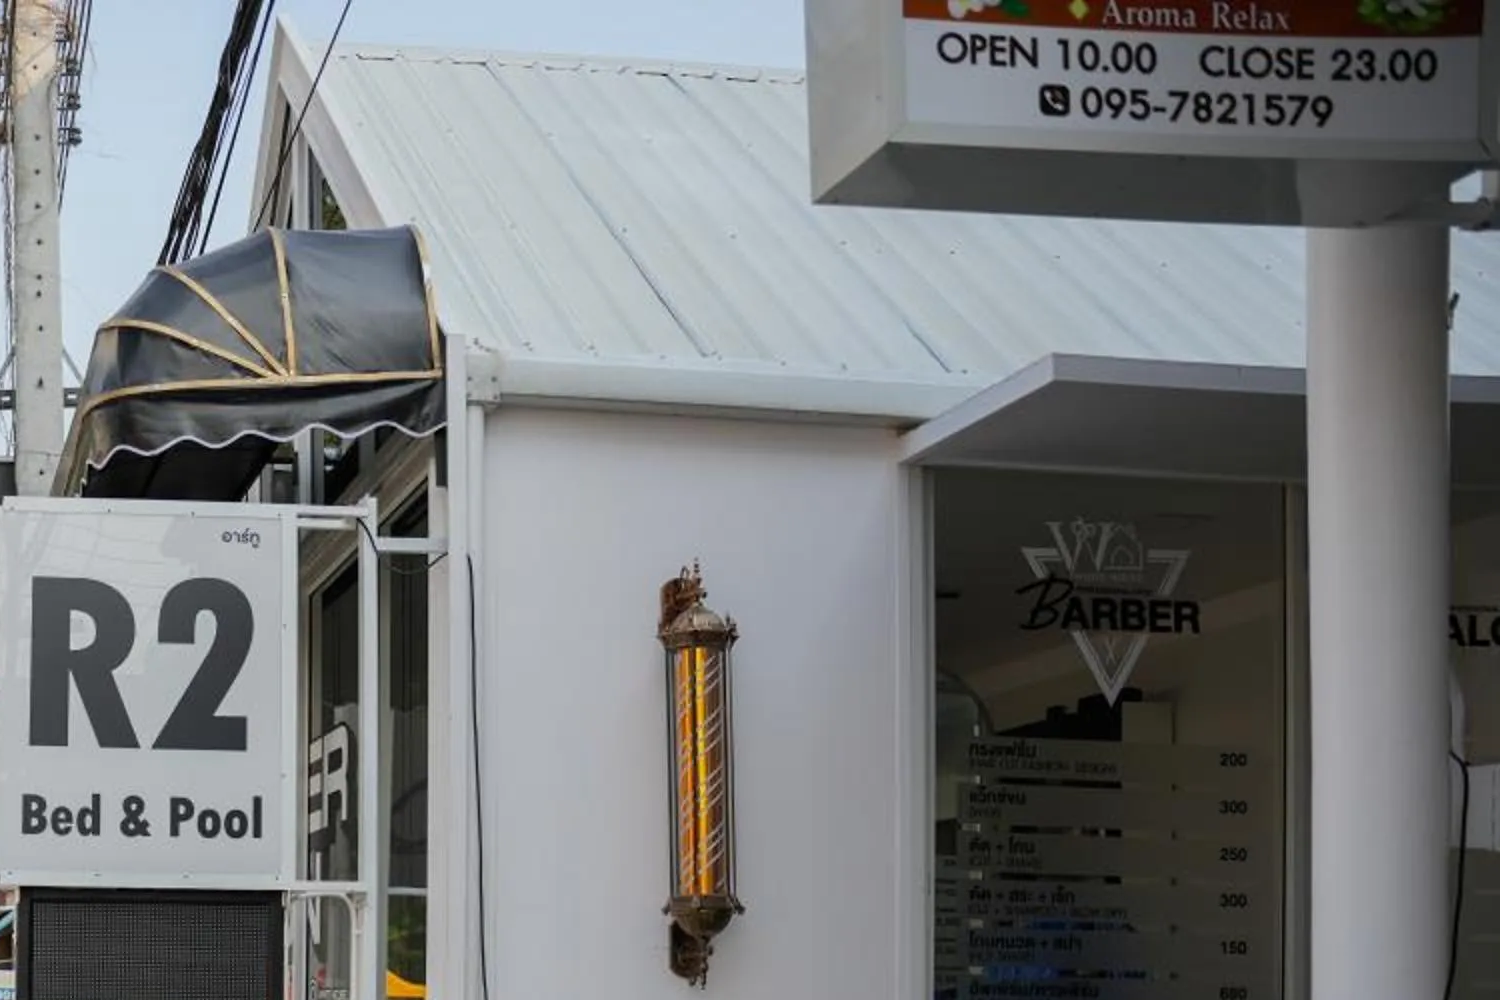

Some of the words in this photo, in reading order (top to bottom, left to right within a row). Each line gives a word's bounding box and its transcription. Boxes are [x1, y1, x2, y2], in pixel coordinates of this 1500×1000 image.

[1102, 0, 1197, 28] Aroma
[1212, 0, 1290, 31] Relax
[936, 31, 1039, 69] OPEN
[1056, 38, 1158, 75] 10.00
[1199, 45, 1315, 80] CLOSE
[1331, 48, 1438, 82] 23.00
[1080, 86, 1334, 128] 095-7821579
[221, 527, 261, 549] อาร์ทู
[1014, 572, 1201, 634] BARBER
[28, 576, 255, 752] R2
[1219, 753, 1248, 766] 200
[21, 793, 101, 837] Bed
[119, 794, 152, 838] &
[169, 795, 263, 839] Pool
[1219, 847, 1248, 861] 250
[1220, 941, 1248, 955] 150
